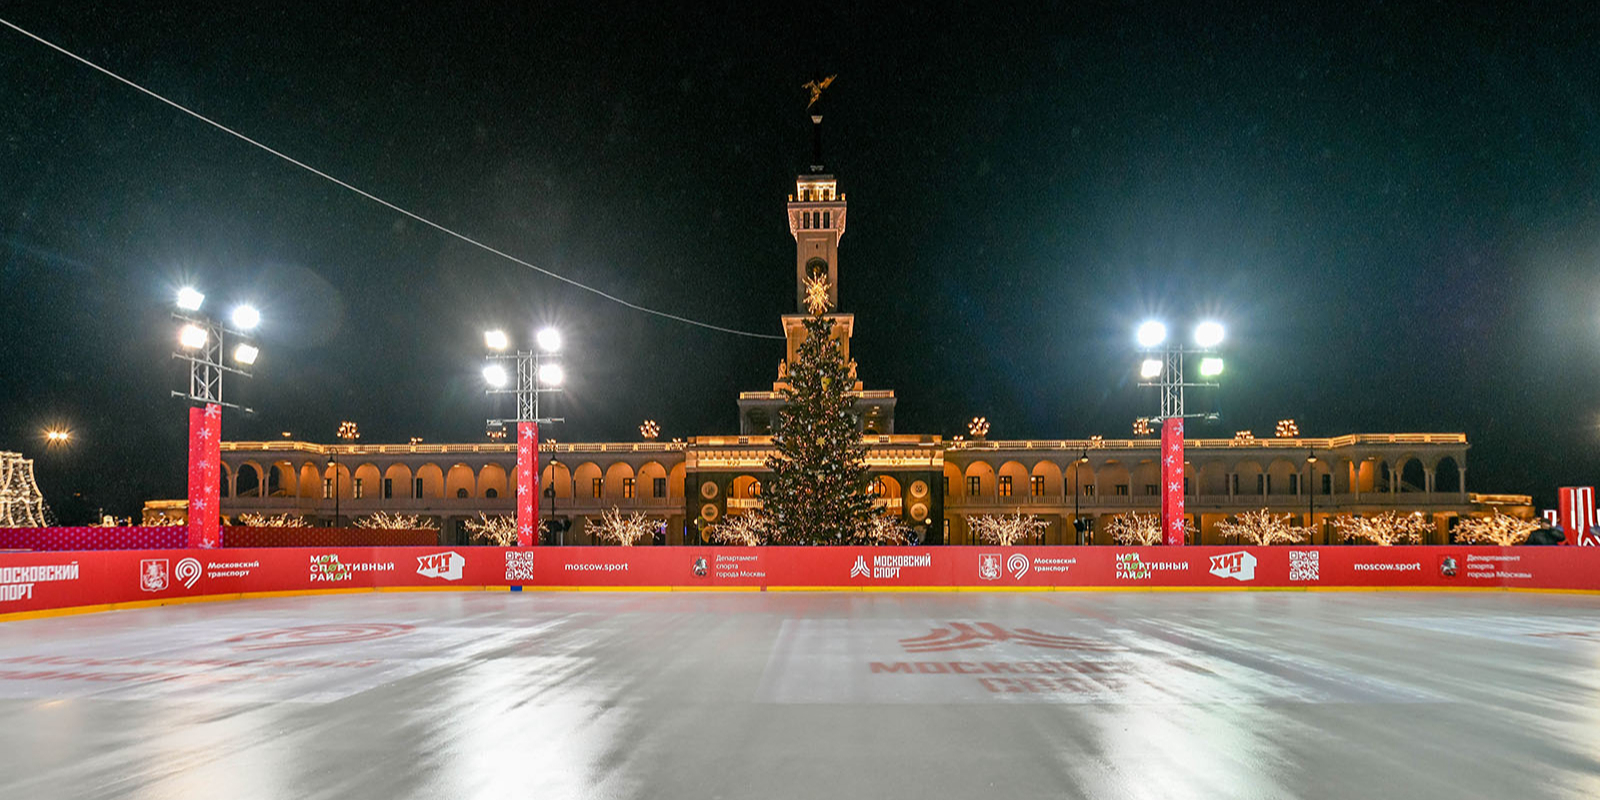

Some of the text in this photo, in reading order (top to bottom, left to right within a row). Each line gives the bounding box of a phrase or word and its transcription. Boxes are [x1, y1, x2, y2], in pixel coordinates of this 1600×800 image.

[310, 554, 339, 564] МОЙ
[873, 553, 931, 567] МОСКОВСКИЙ
[1116, 553, 1140, 561] МОЙ
[1212, 553, 1244, 570] ХИТ
[1466, 554, 1520, 562] Департамент
[207, 561, 260, 570] Московский
[419, 554, 452, 571] ХИТ
[1116, 561, 1189, 570] СПОРТИВНЫЙ
[1354, 562, 1421, 571] moscow.sport
[310, 562, 395, 573] СПОРТИВНЫЙ
[564, 563, 629, 572] moscow.sport
[207, 569, 250, 579] транспорт
[873, 567, 900, 578] СПОРТ
[1116, 570, 1151, 579] РАЙОН
[1496, 571, 1532, 579] Москвы
[310, 573, 352, 582] РАЙОН
